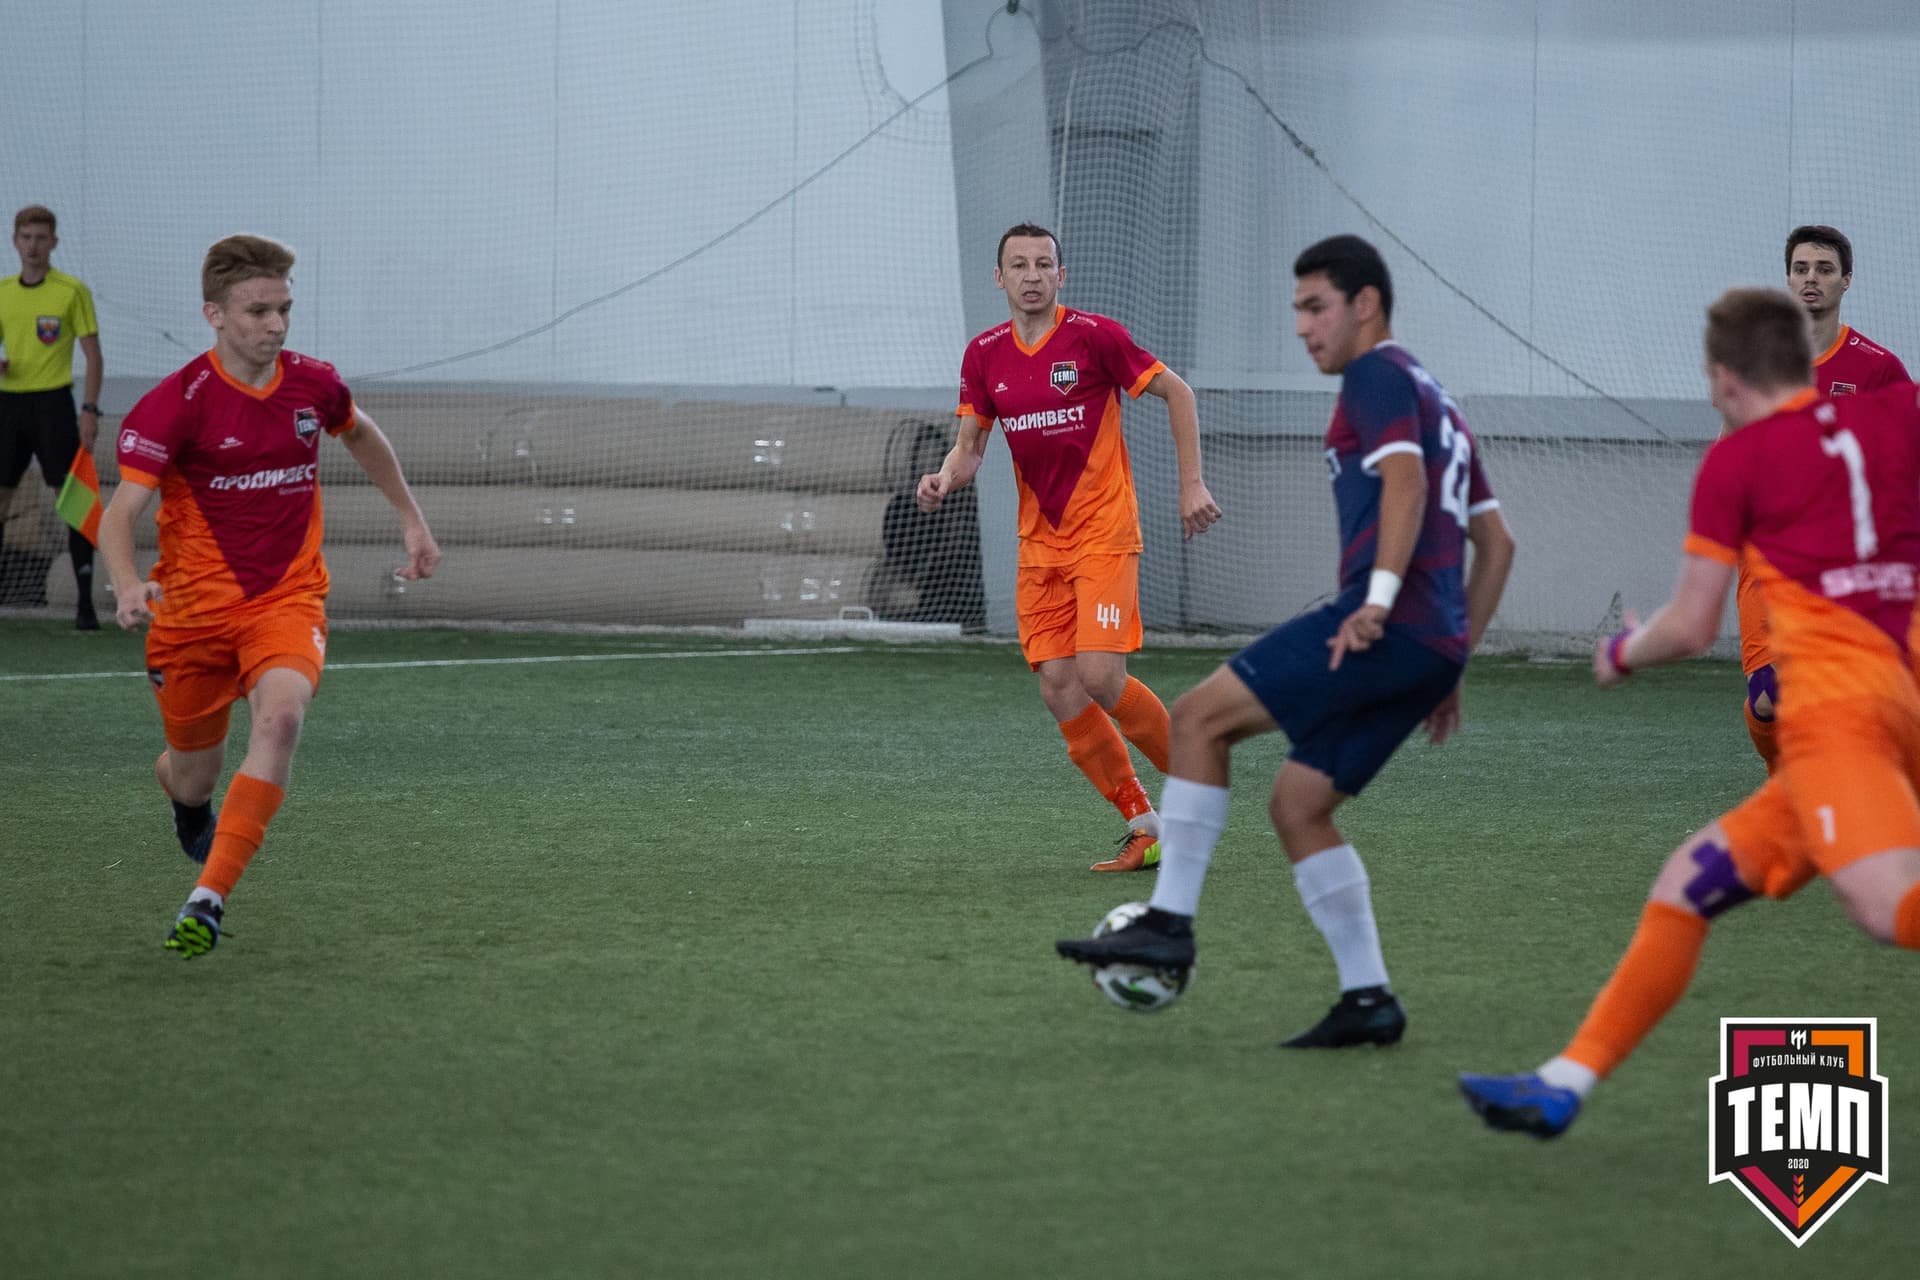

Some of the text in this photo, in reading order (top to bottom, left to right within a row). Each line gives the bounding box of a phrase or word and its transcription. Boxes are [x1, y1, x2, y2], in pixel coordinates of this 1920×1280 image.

[1053, 370, 1076, 383] ТЕМП
[1820, 429, 1878, 560] 1
[1097, 603, 1120, 630] 44
[1816, 805, 1836, 845] 1
